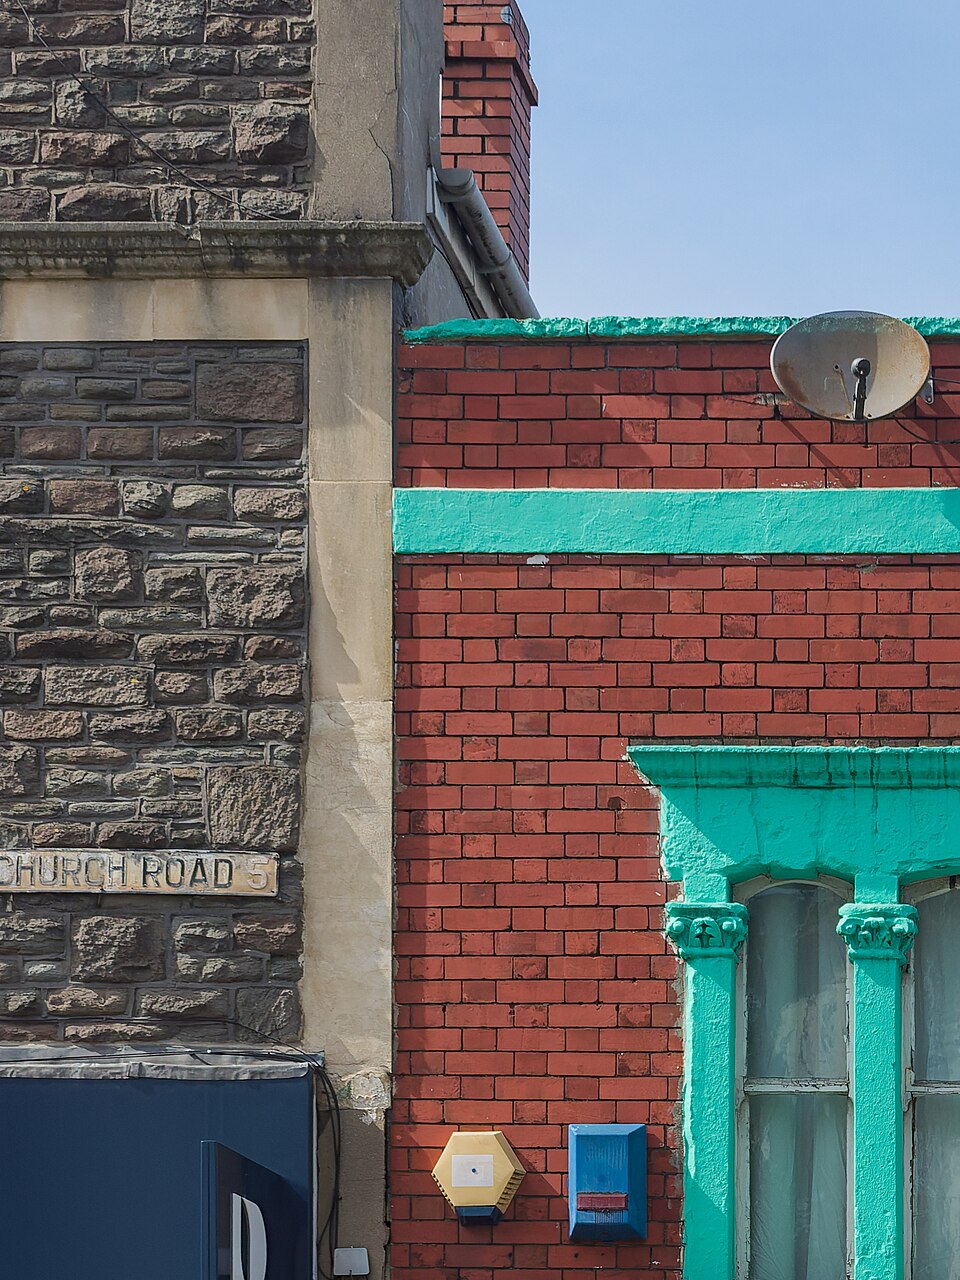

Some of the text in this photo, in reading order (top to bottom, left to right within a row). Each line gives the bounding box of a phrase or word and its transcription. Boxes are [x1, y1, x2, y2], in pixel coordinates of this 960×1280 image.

[0, 857, 271, 890] CHURCH ROAD 5
